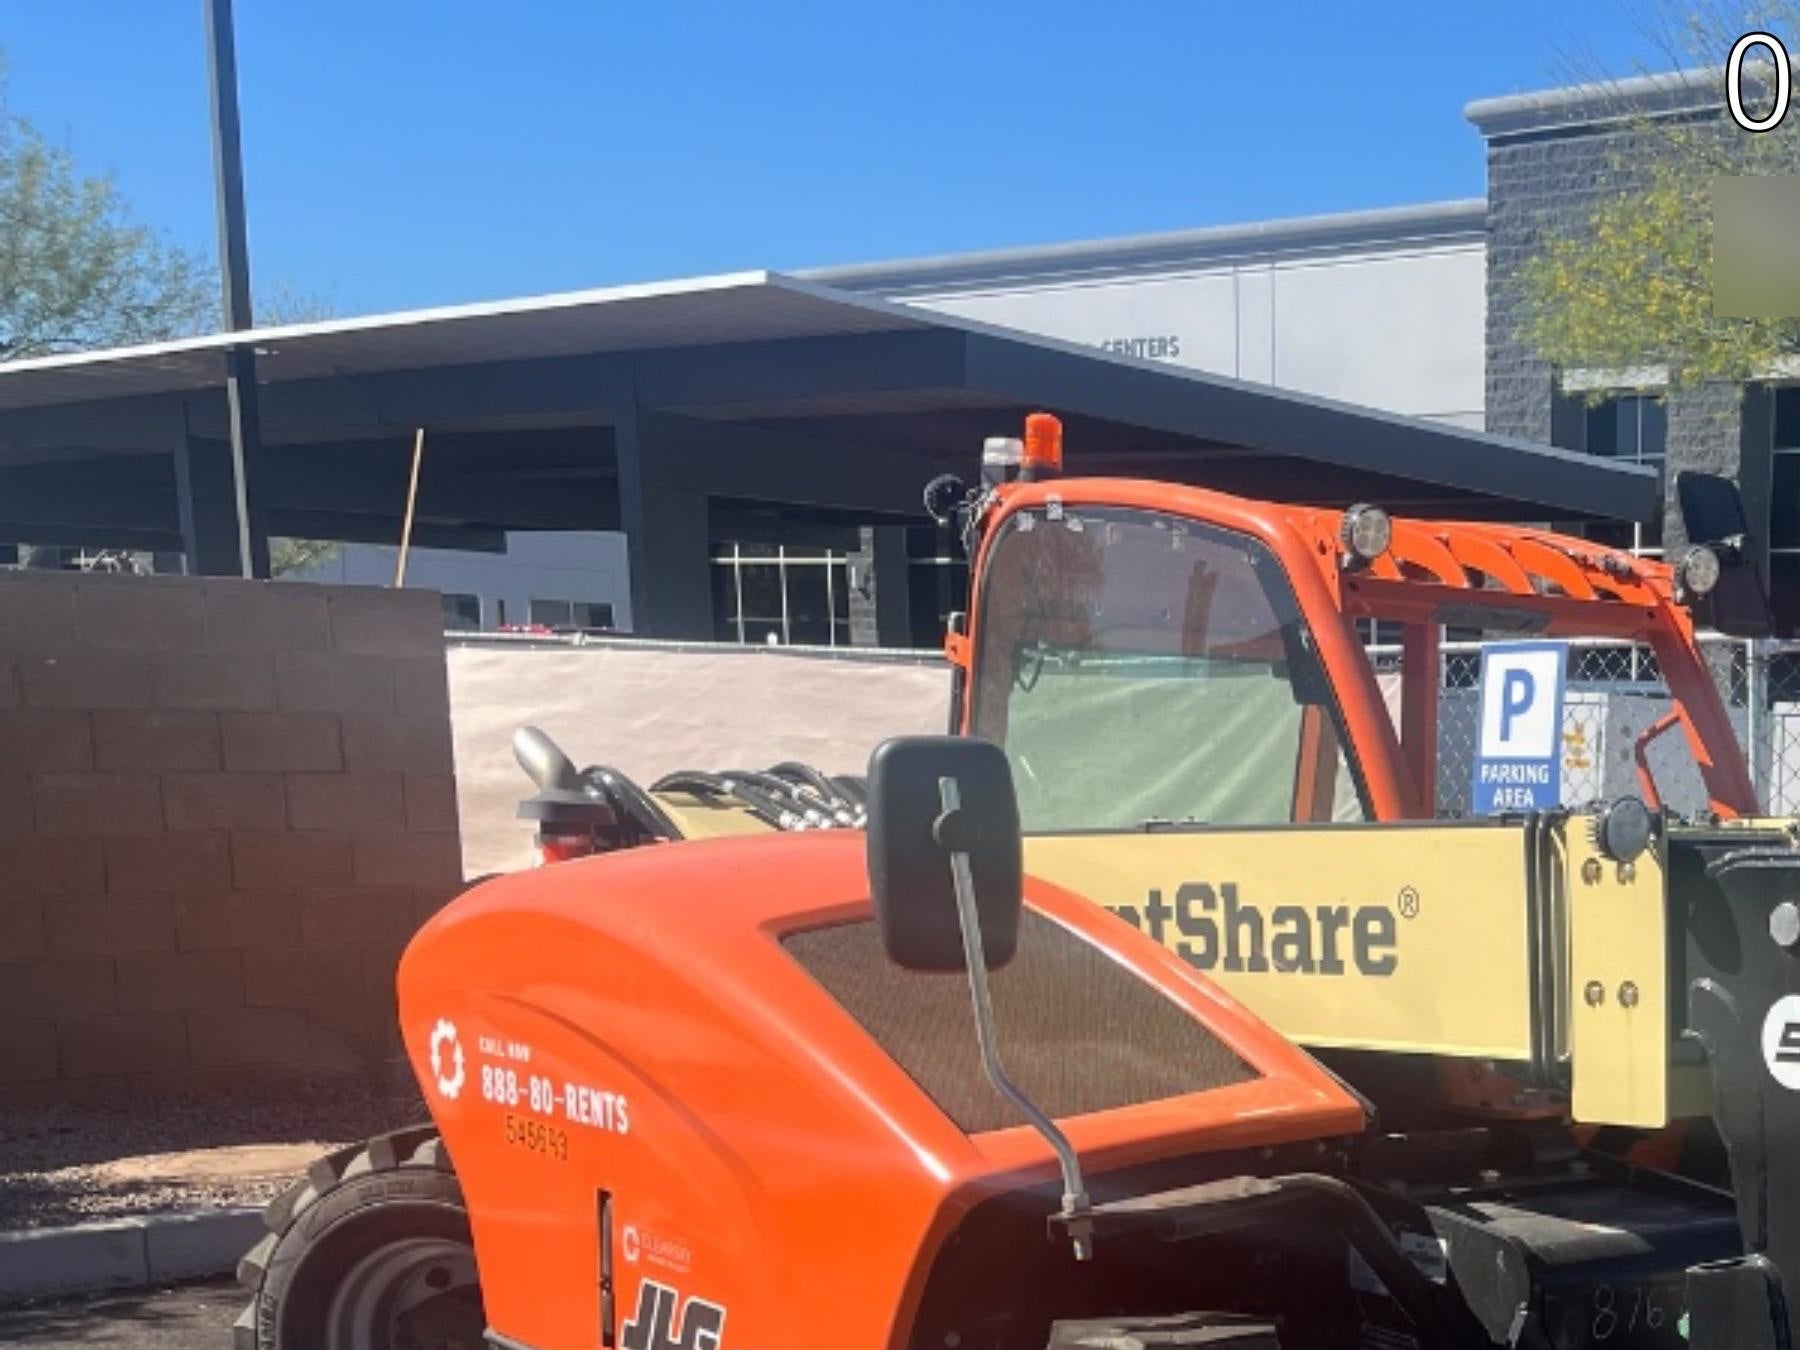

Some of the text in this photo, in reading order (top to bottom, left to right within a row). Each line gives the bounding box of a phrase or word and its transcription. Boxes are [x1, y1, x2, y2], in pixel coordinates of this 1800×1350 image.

[1499, 668, 1536, 742] P
[1480, 764, 1550, 784] PARKING
[1493, 788, 1535, 807] AREA
[481, 1064, 629, 1135] 888-80-RENTS
